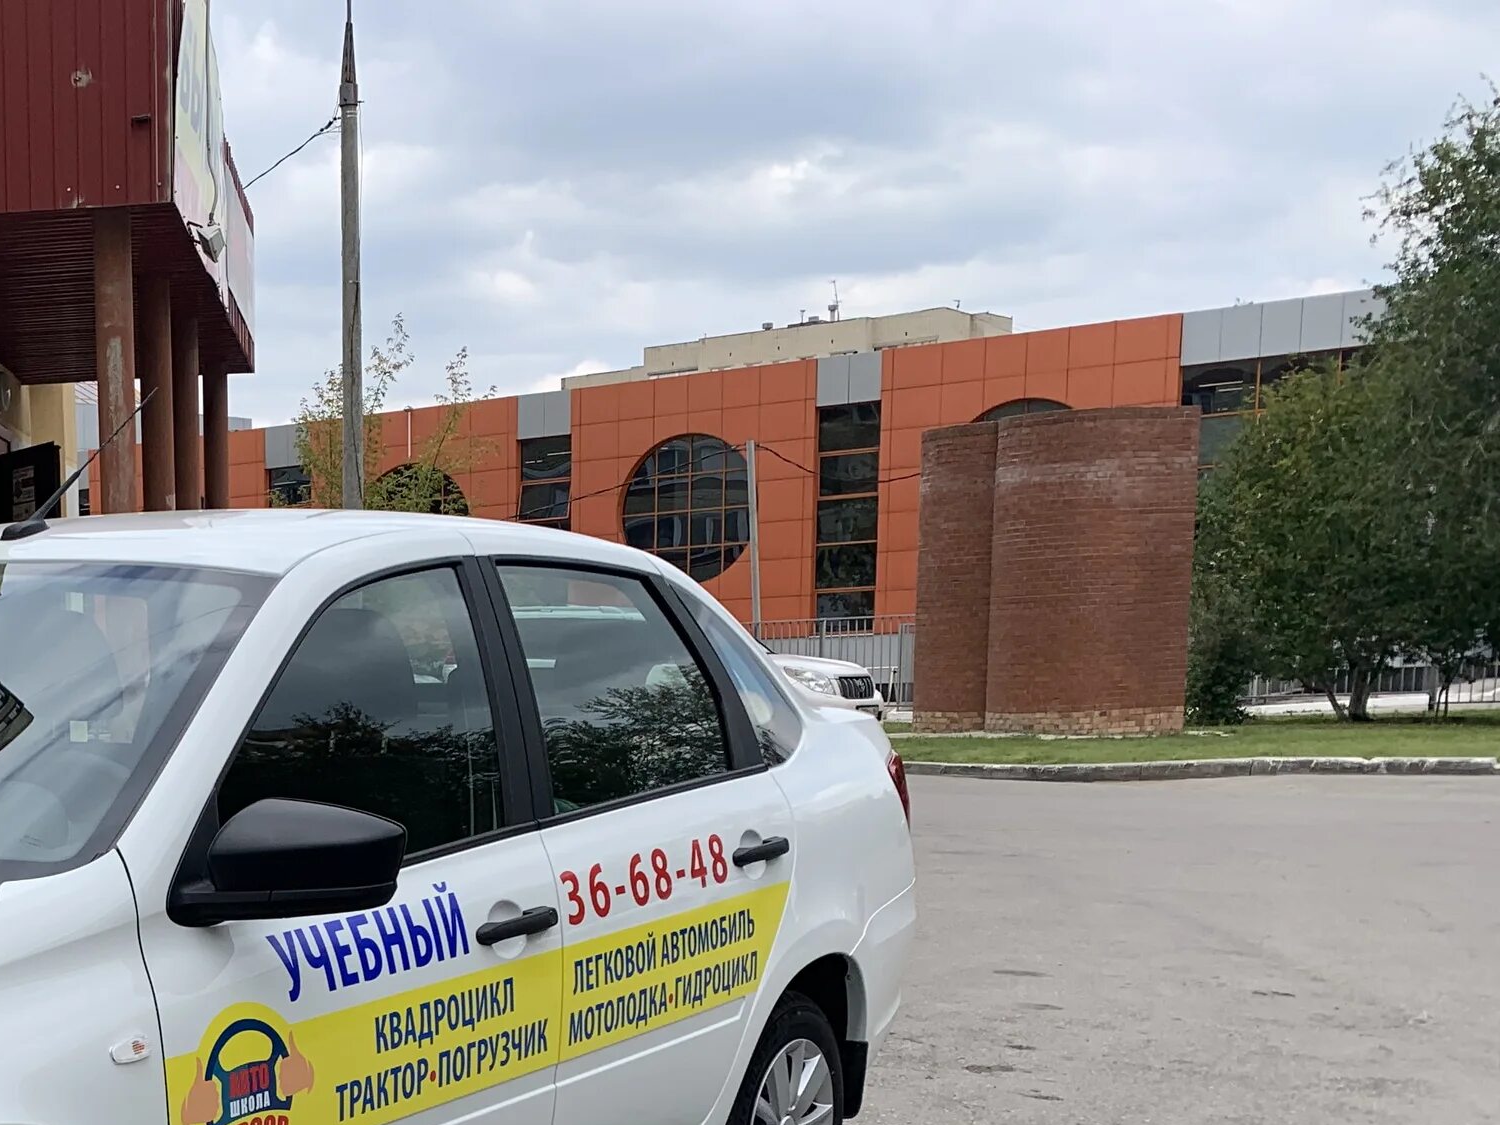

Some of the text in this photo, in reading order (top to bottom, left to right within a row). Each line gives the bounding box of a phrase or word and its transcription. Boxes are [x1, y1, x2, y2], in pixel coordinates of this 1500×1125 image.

[559, 833, 728, 926] 36-68-48
[265, 881, 470, 1002] УЧЕБНЫЙ
[572, 908, 755, 995] ЛЕГКОВОЙ АВТОМОБИЛЬ
[374, 976, 515, 1054] КВАДРОЦИКЛ
[229, 1062, 270, 1099] АВТО
[229, 1090, 271, 1118] ШКОЛА
